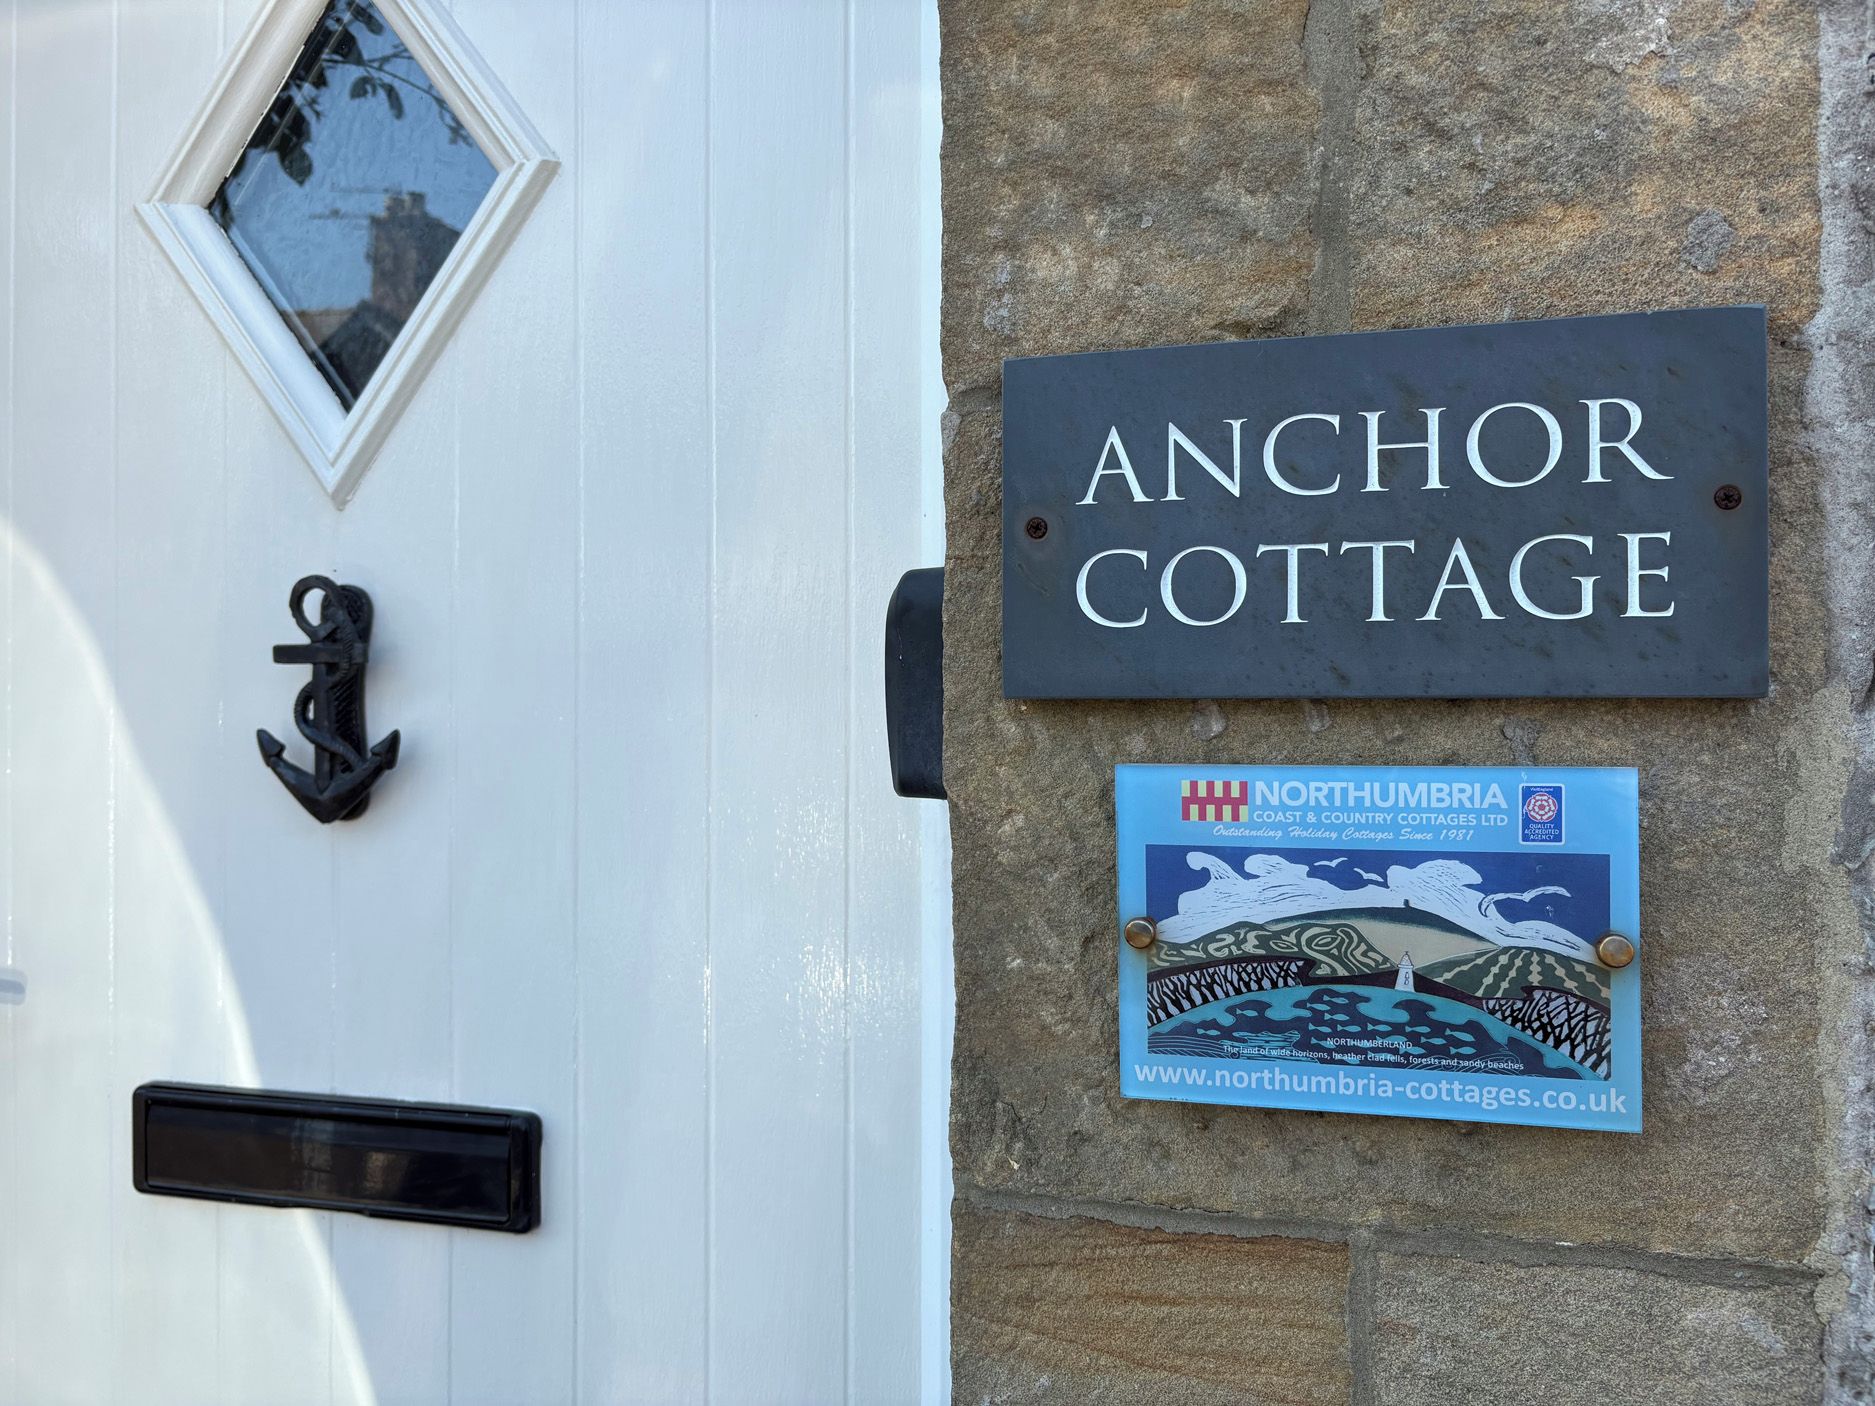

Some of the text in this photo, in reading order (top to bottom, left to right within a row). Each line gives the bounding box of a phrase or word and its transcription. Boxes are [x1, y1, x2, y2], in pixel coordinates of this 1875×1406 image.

[1075, 397, 1674, 506] ANCHOR
[1075, 531, 1675, 629] COTTAGE
[1255, 780, 1509, 809] NORTHUMBRIA
[1253, 811, 1509, 826] COAST & COUNTRY COTTAGES LTD
[1213, 824, 1475, 842] Outstanding Holiday Cottages Since 1981
[1327, 1037, 1413, 1049] NORTHUMBERLAND
[1224, 1045, 1524, 1070] The land of wide horizons, heather clad fells, forests and sandy beaches
[1134, 1064, 1627, 1114] www.northumbria-cottages.co.uk
